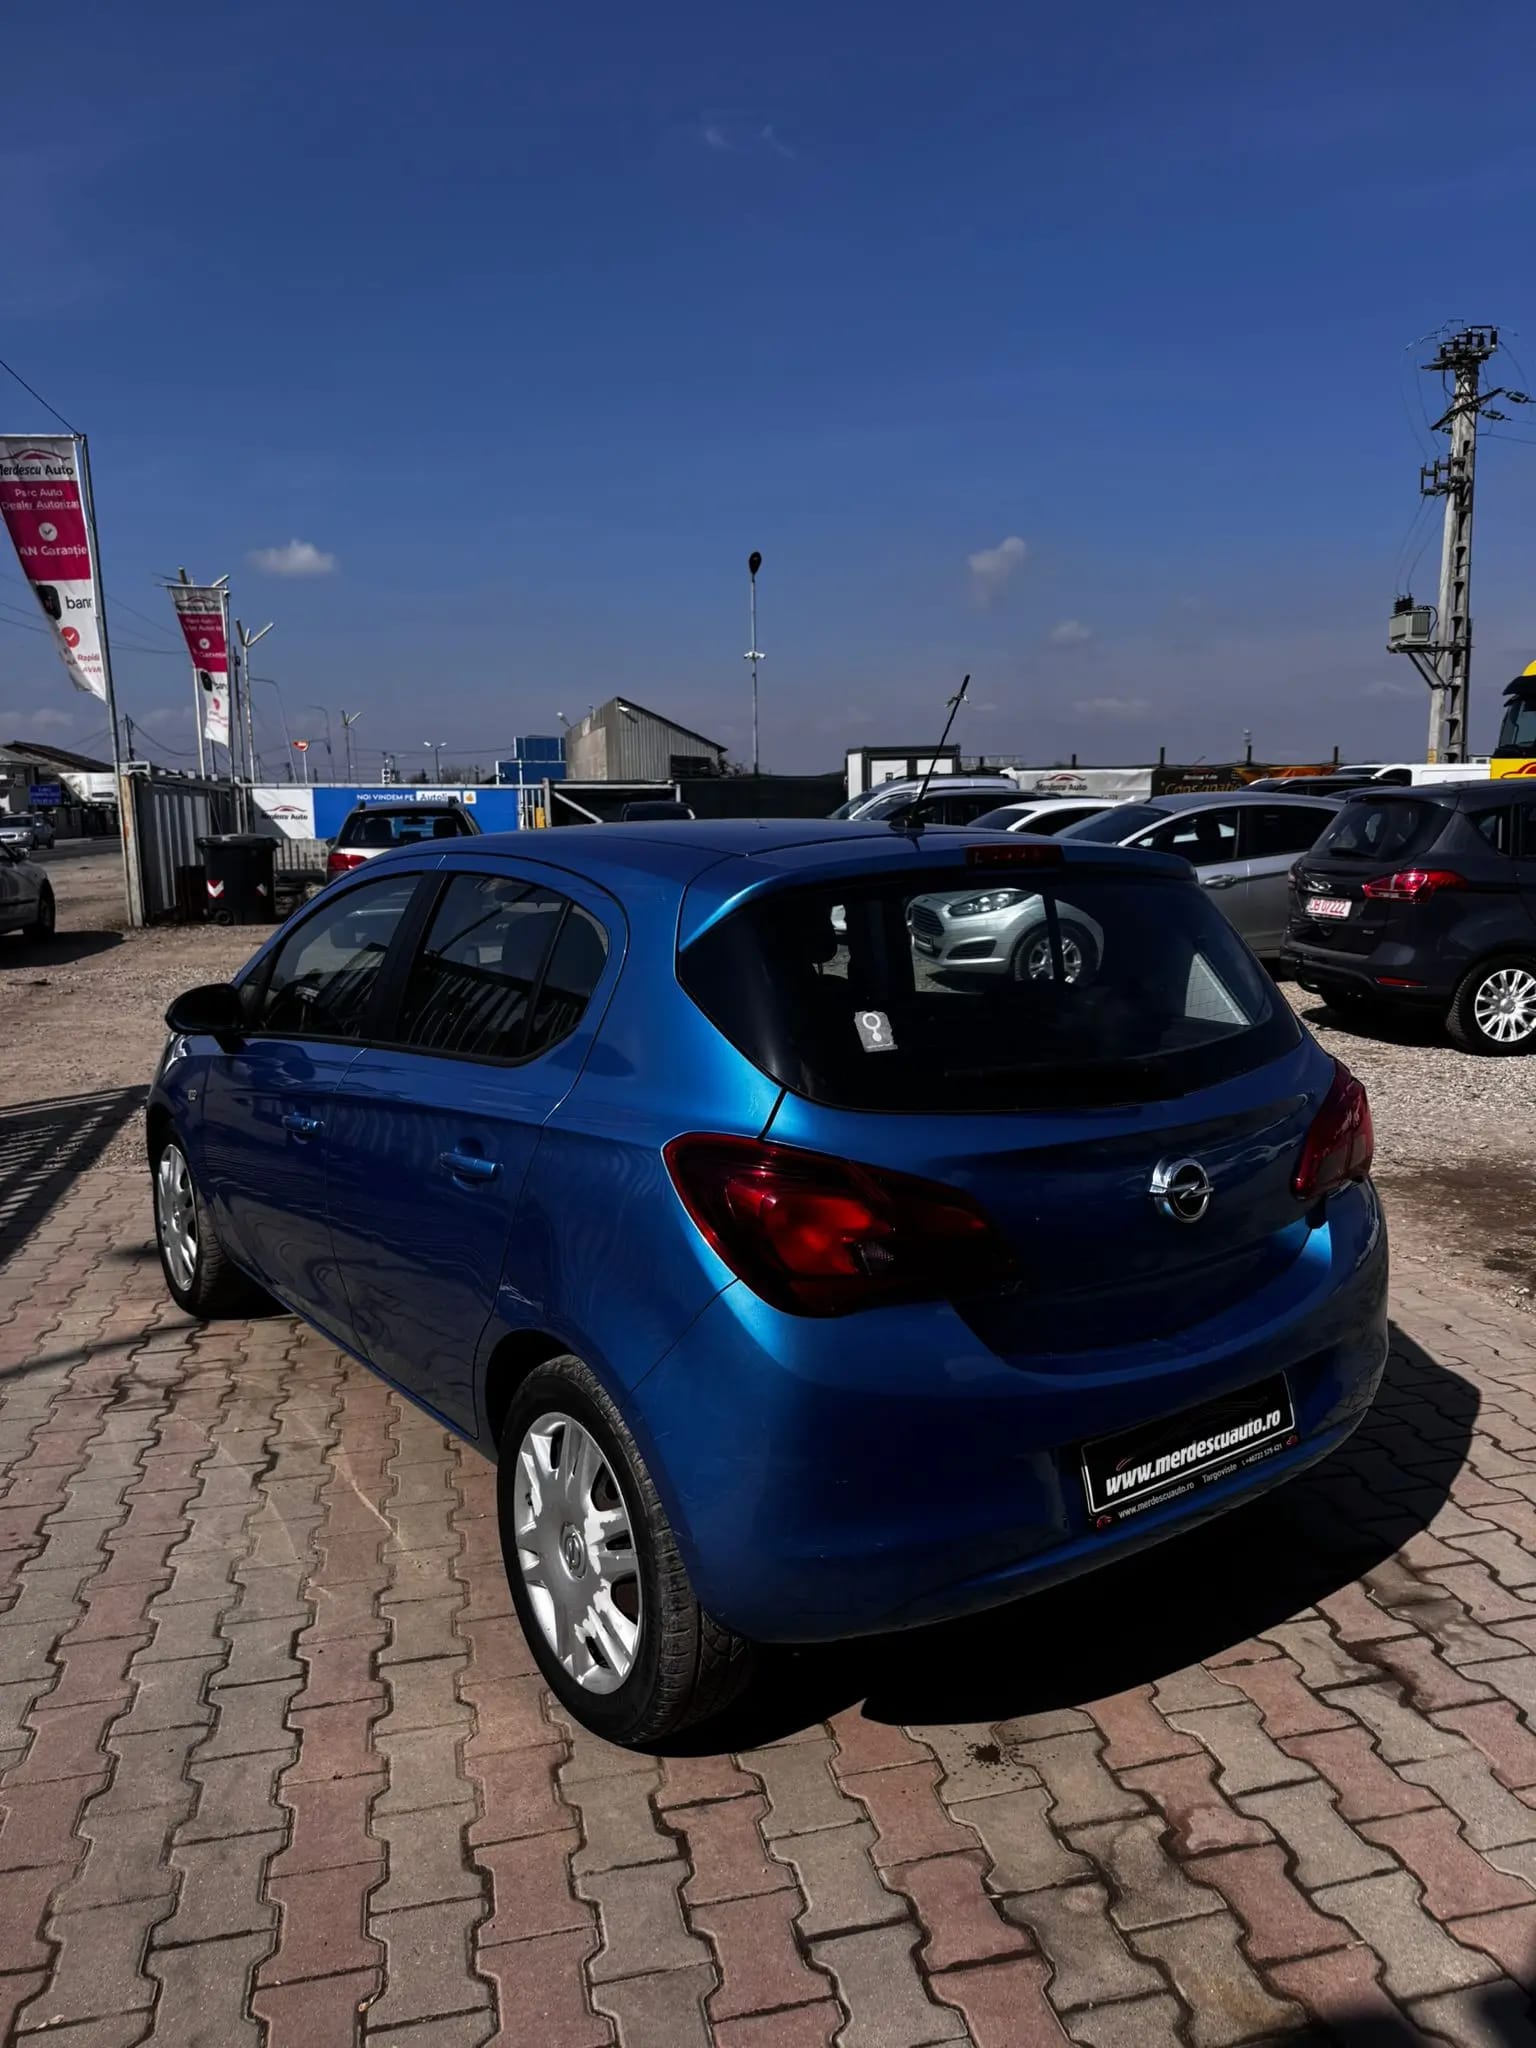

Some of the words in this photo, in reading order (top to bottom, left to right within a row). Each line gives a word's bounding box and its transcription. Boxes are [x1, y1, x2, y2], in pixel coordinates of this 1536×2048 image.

[45, 464, 74, 475] Auto
[14, 488, 37, 497] Parc
[40, 488, 63, 496] Auto
[357, 793, 372, 801] NOI
[372, 793, 403, 801] VINDEM
[1106, 1409, 1280, 1496] www.merdescuauto.ro
[1118, 1481, 1195, 1519] www.merdescuauto.ro
